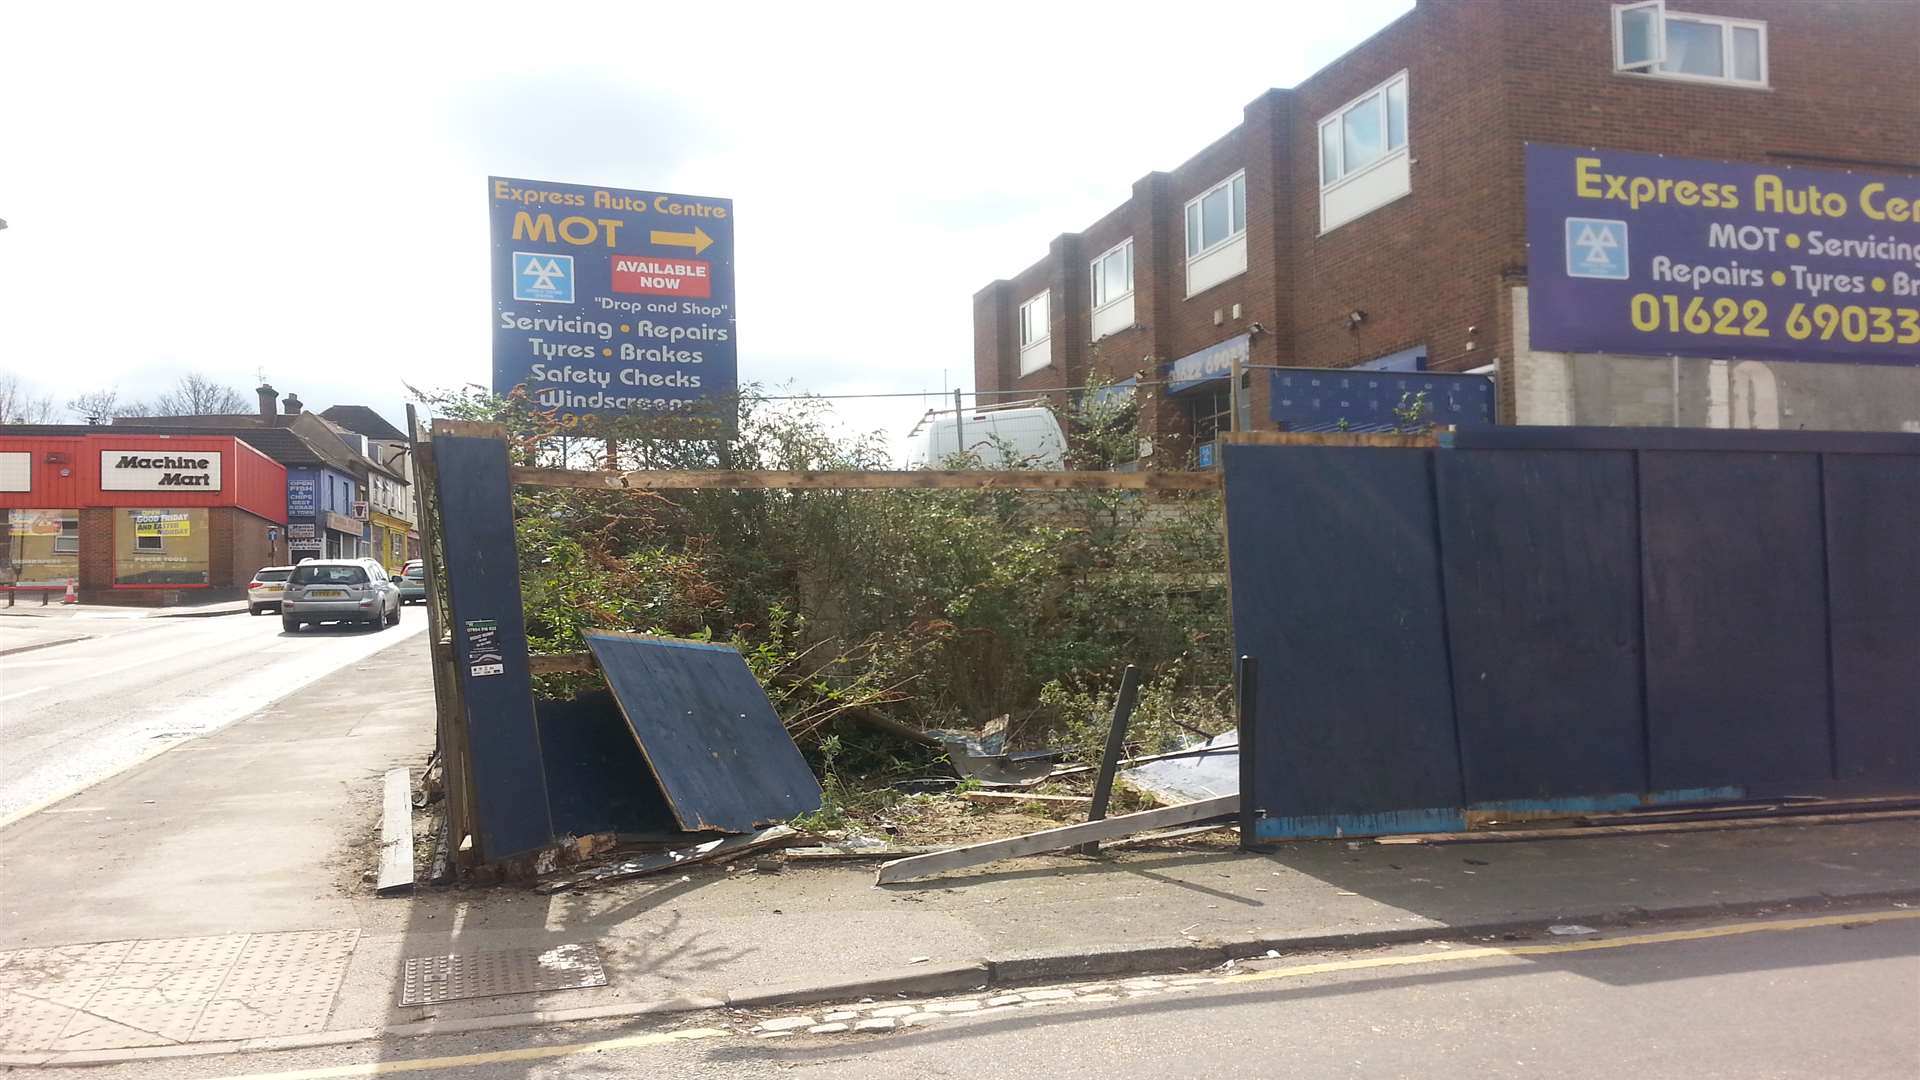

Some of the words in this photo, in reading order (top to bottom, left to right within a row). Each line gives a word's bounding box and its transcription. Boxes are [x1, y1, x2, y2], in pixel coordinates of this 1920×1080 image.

[495, 181, 585, 206] Express
[594, 191, 648, 212] Auto
[654, 197, 728, 219] Centre
[1575, 157, 1739, 210] Express
[1754, 174, 1847, 218] Auto
[512, 211, 624, 248] MOT
[1709, 223, 1780, 252] MOT
[616, 260, 707, 278] AVAILABLE
[1652, 256, 1764, 291] Repairs
[1791, 265, 1865, 298] Tyres
[640, 276, 681, 290] NOW
[594, 297, 642, 313] "Drop
[647, 300, 677, 314] and
[682, 302, 728, 317] Shop"
[1631, 293, 1770, 338] 01622
[501, 311, 613, 340] Servicing
[637, 320, 729, 343] Repairs
[528, 338, 595, 360] Tyres
[620, 343, 703, 364] Brakes
[531, 364, 610, 389] Safety
[619, 368, 702, 389] Checks
[115, 455, 210, 469] Machine
[158, 472, 211, 486] Mart
[136, 515, 160, 523] GOOD
[160, 513, 189, 522] FRIDAY
